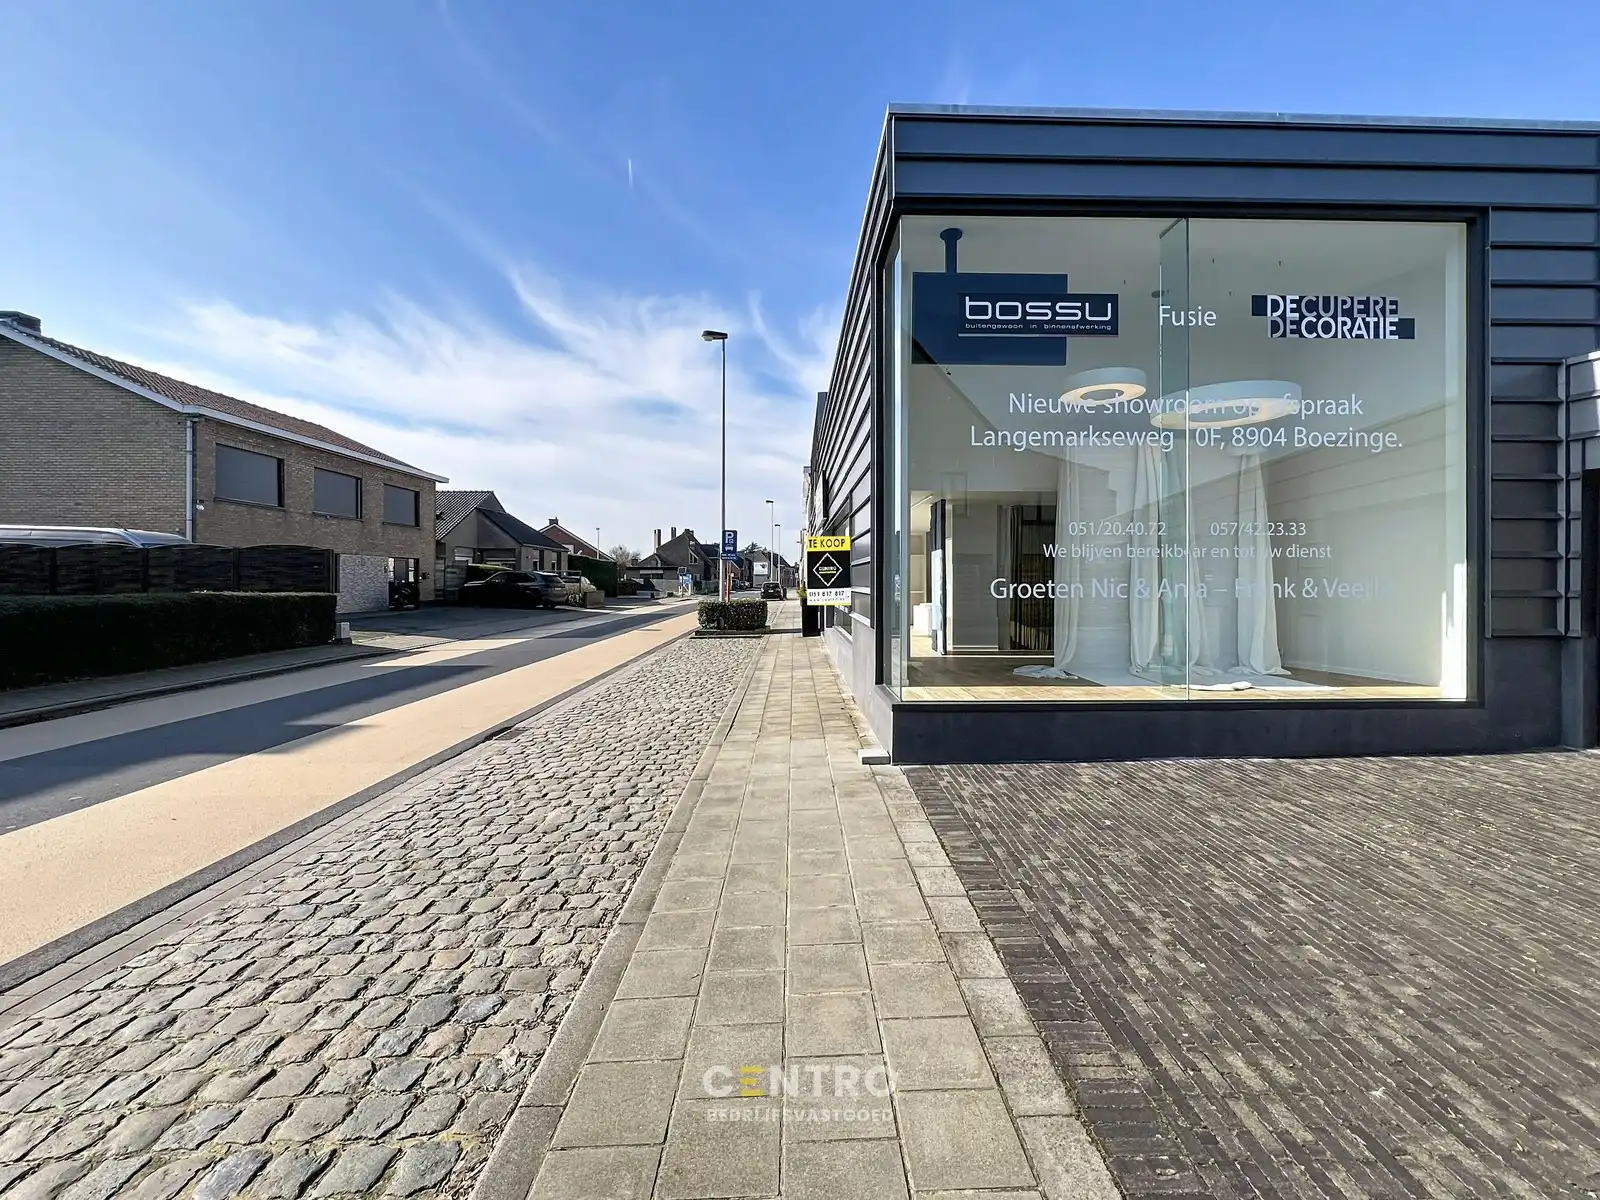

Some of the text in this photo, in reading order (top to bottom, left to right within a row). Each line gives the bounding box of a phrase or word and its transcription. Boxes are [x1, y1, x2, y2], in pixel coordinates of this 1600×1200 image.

[965, 296, 1112, 321] bossu
[1159, 305, 1217, 327] Fusie
[1266, 294, 1400, 317] DECUPERE
[1043, 323, 1112, 331] binnenafwerking
[1266, 317, 1400, 339] DECORATIE
[1008, 392, 1096, 414] Nieuwe
[1103, 392, 1225, 414] showroom
[970, 425, 1174, 452] Langemarkseweg
[1231, 426, 1287, 447] 8904
[1294, 426, 1403, 453] Boezinge.
[725, 531, 734, 544] P
[1068, 521, 1166, 536] 051/20.40.72
[808, 538, 845, 548] TE KOOP
[1042, 543, 1067, 558] We
[1071, 543, 1122, 562] blijven
[1210, 546, 1229, 558] en
[1234, 545, 1255, 558] tot
[1285, 543, 1332, 559] dienst
[990, 577, 1083, 599] Groeten
[1092, 577, 1128, 599] Nic
[1134, 577, 1151, 599] &
[1302, 577, 1318, 599] &
